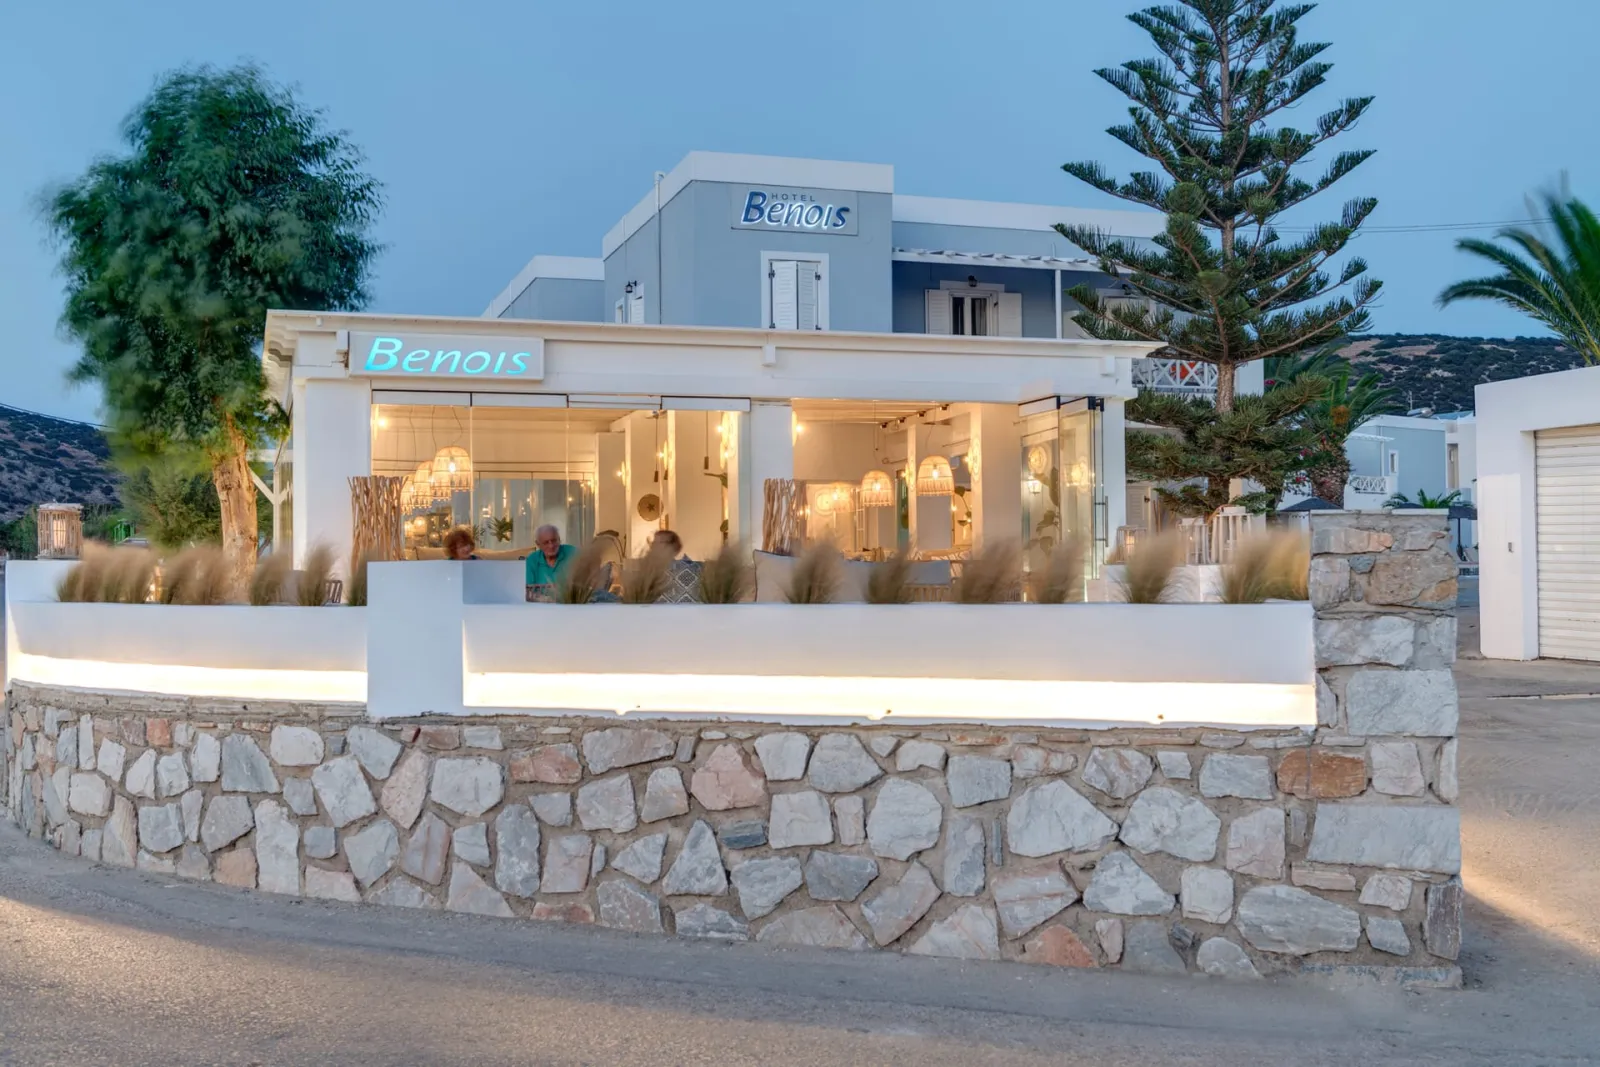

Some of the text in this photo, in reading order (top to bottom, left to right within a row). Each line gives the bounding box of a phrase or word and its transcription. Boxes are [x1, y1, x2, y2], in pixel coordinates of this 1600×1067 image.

[741, 190, 850, 229] Benois
[771, 192, 816, 202] HOTEL
[364, 336, 532, 375] Benois
